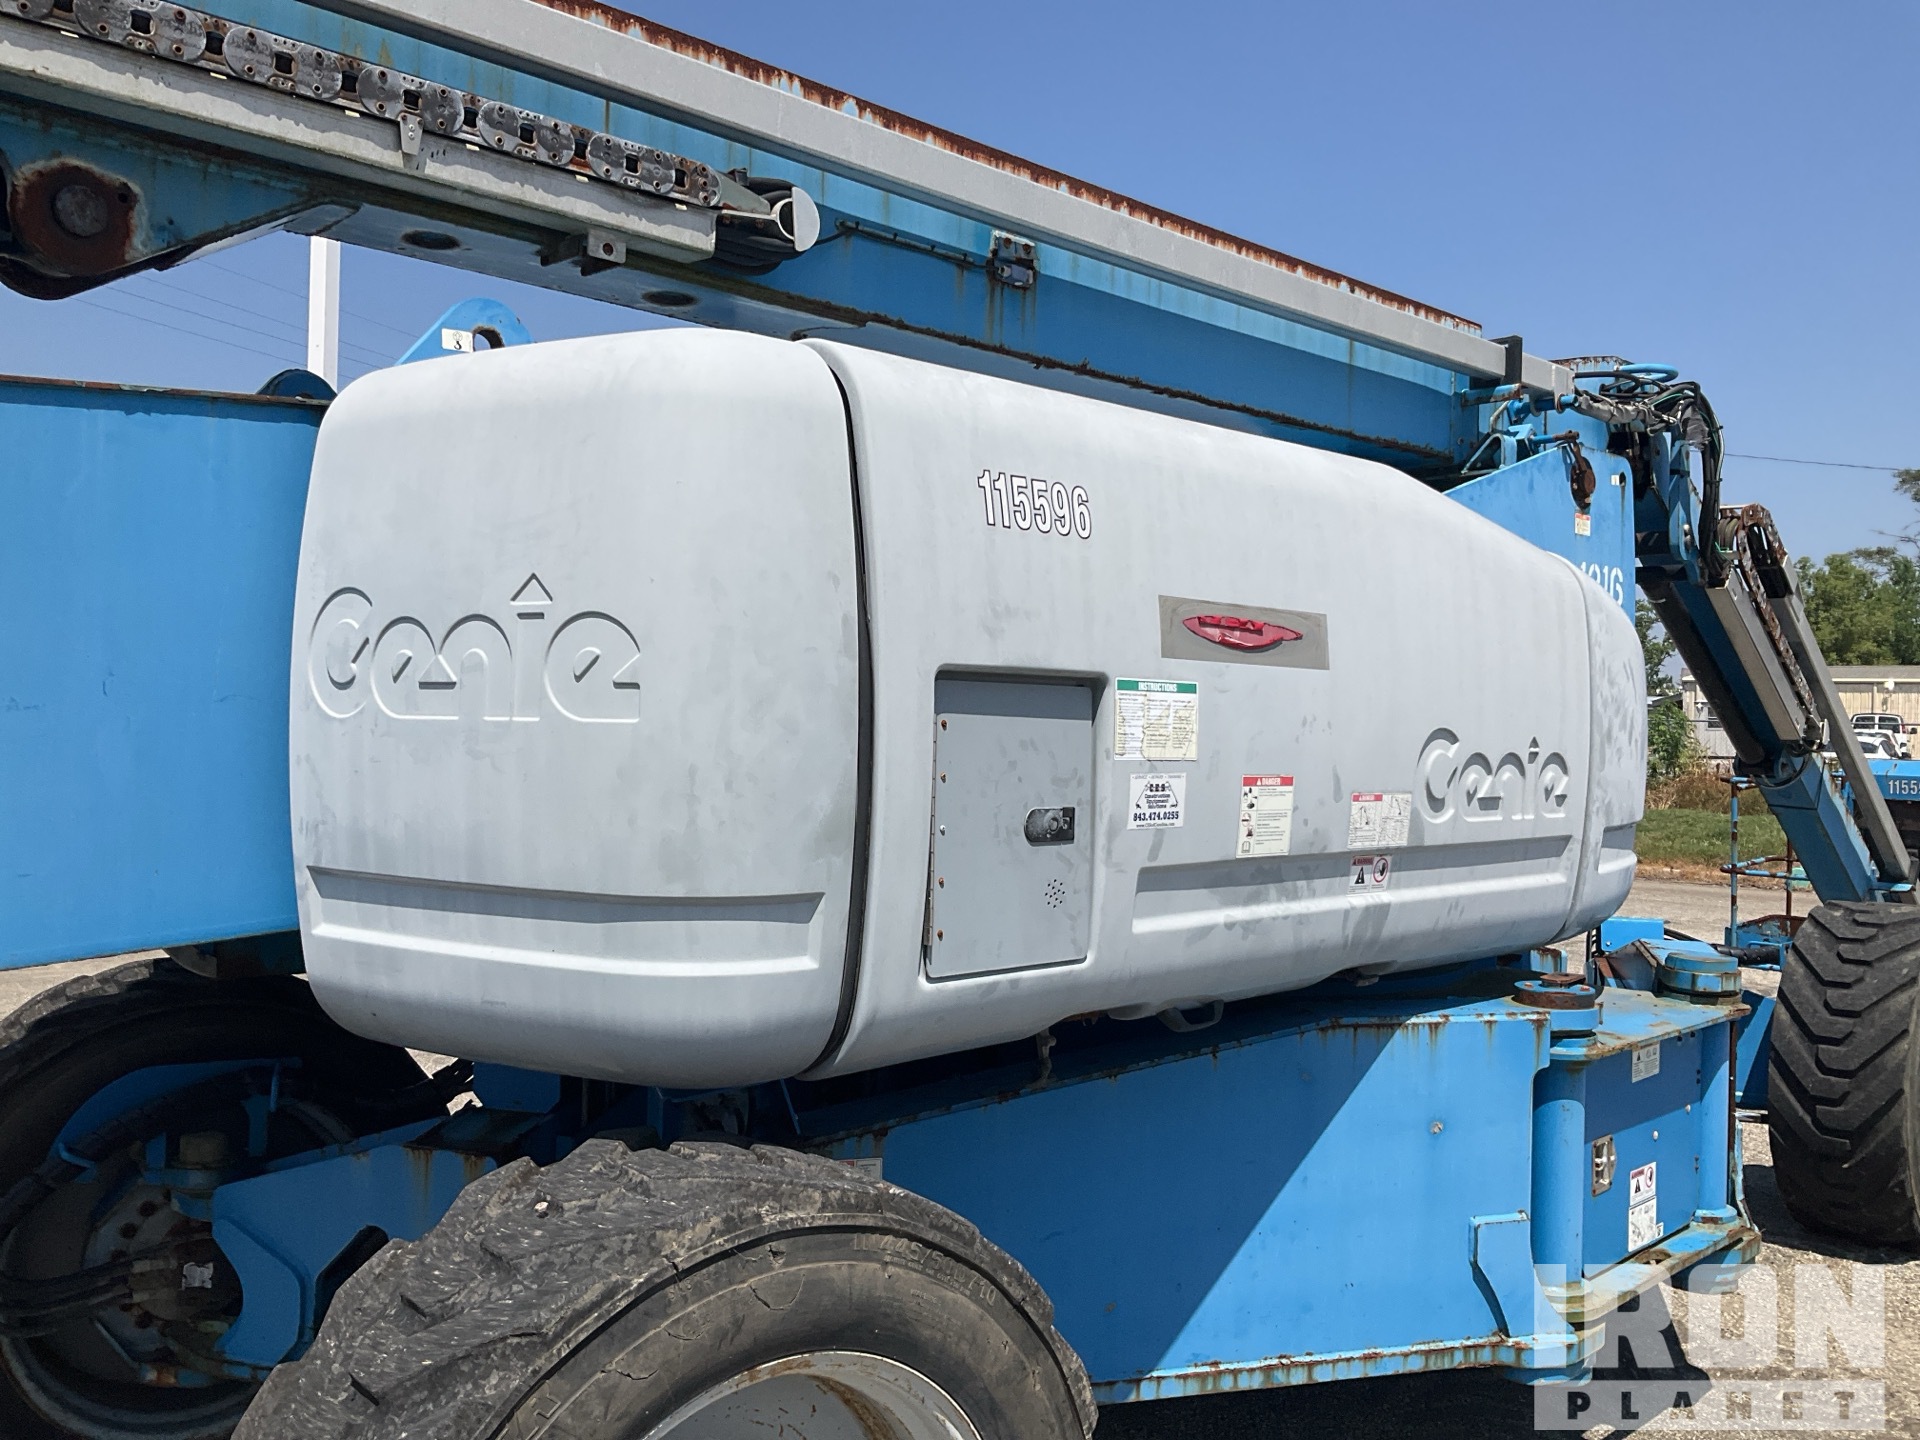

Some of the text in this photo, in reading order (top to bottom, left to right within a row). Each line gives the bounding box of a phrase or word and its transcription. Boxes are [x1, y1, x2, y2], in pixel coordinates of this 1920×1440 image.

[977, 469, 1092, 540] 115596
[1138, 681, 1178, 692] INSTRUCTIONS
[1888, 779, 1920, 795] 1155
[1133, 810, 1179, 822] 843.474.0255
